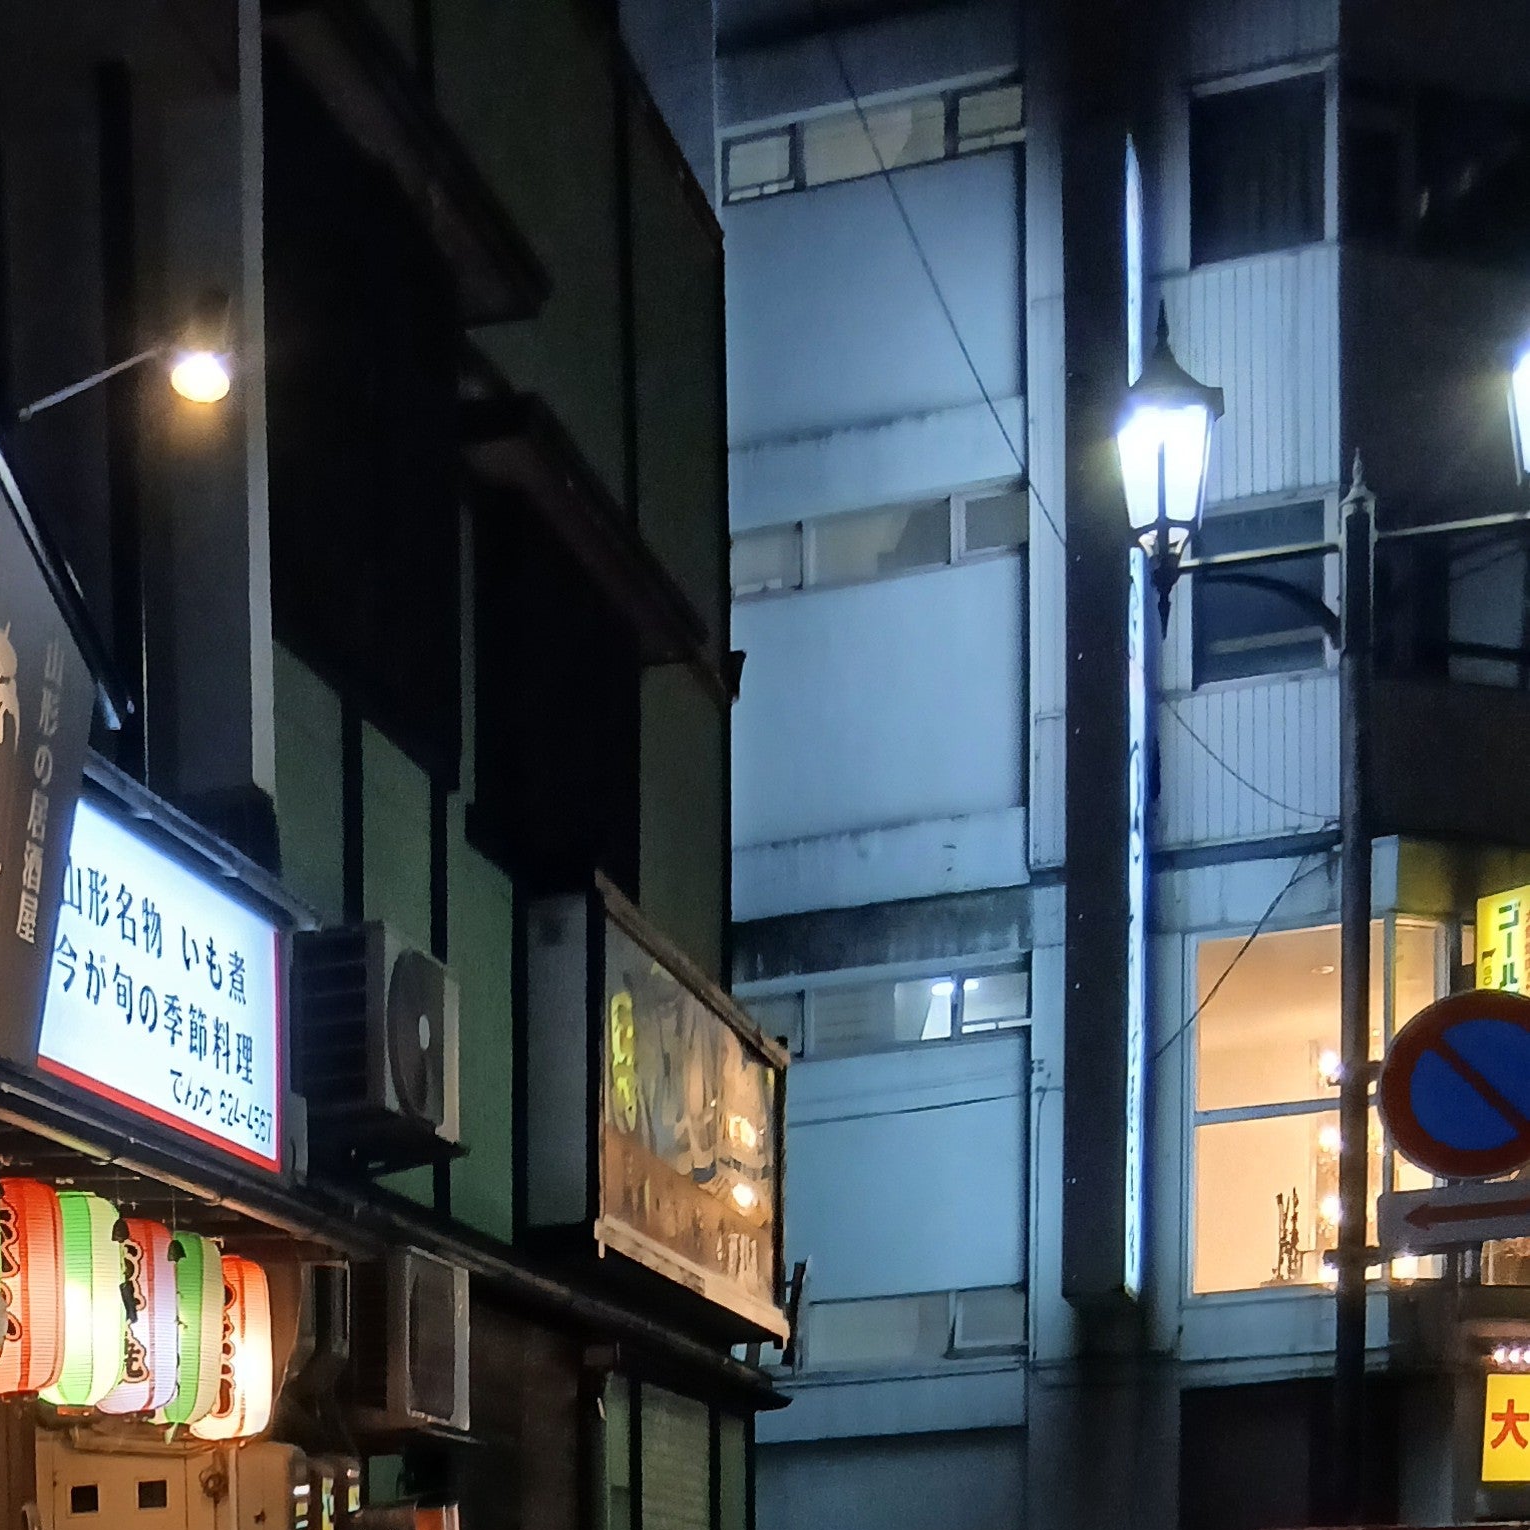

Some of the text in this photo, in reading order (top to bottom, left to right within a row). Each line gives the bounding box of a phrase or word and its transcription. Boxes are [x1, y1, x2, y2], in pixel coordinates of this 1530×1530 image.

[64, 854, 247, 1006] 山形名物 いも煮
[53, 933, 254, 1086] 今が旬の季節料理
[1490, 1398, 1530, 1450] 大
